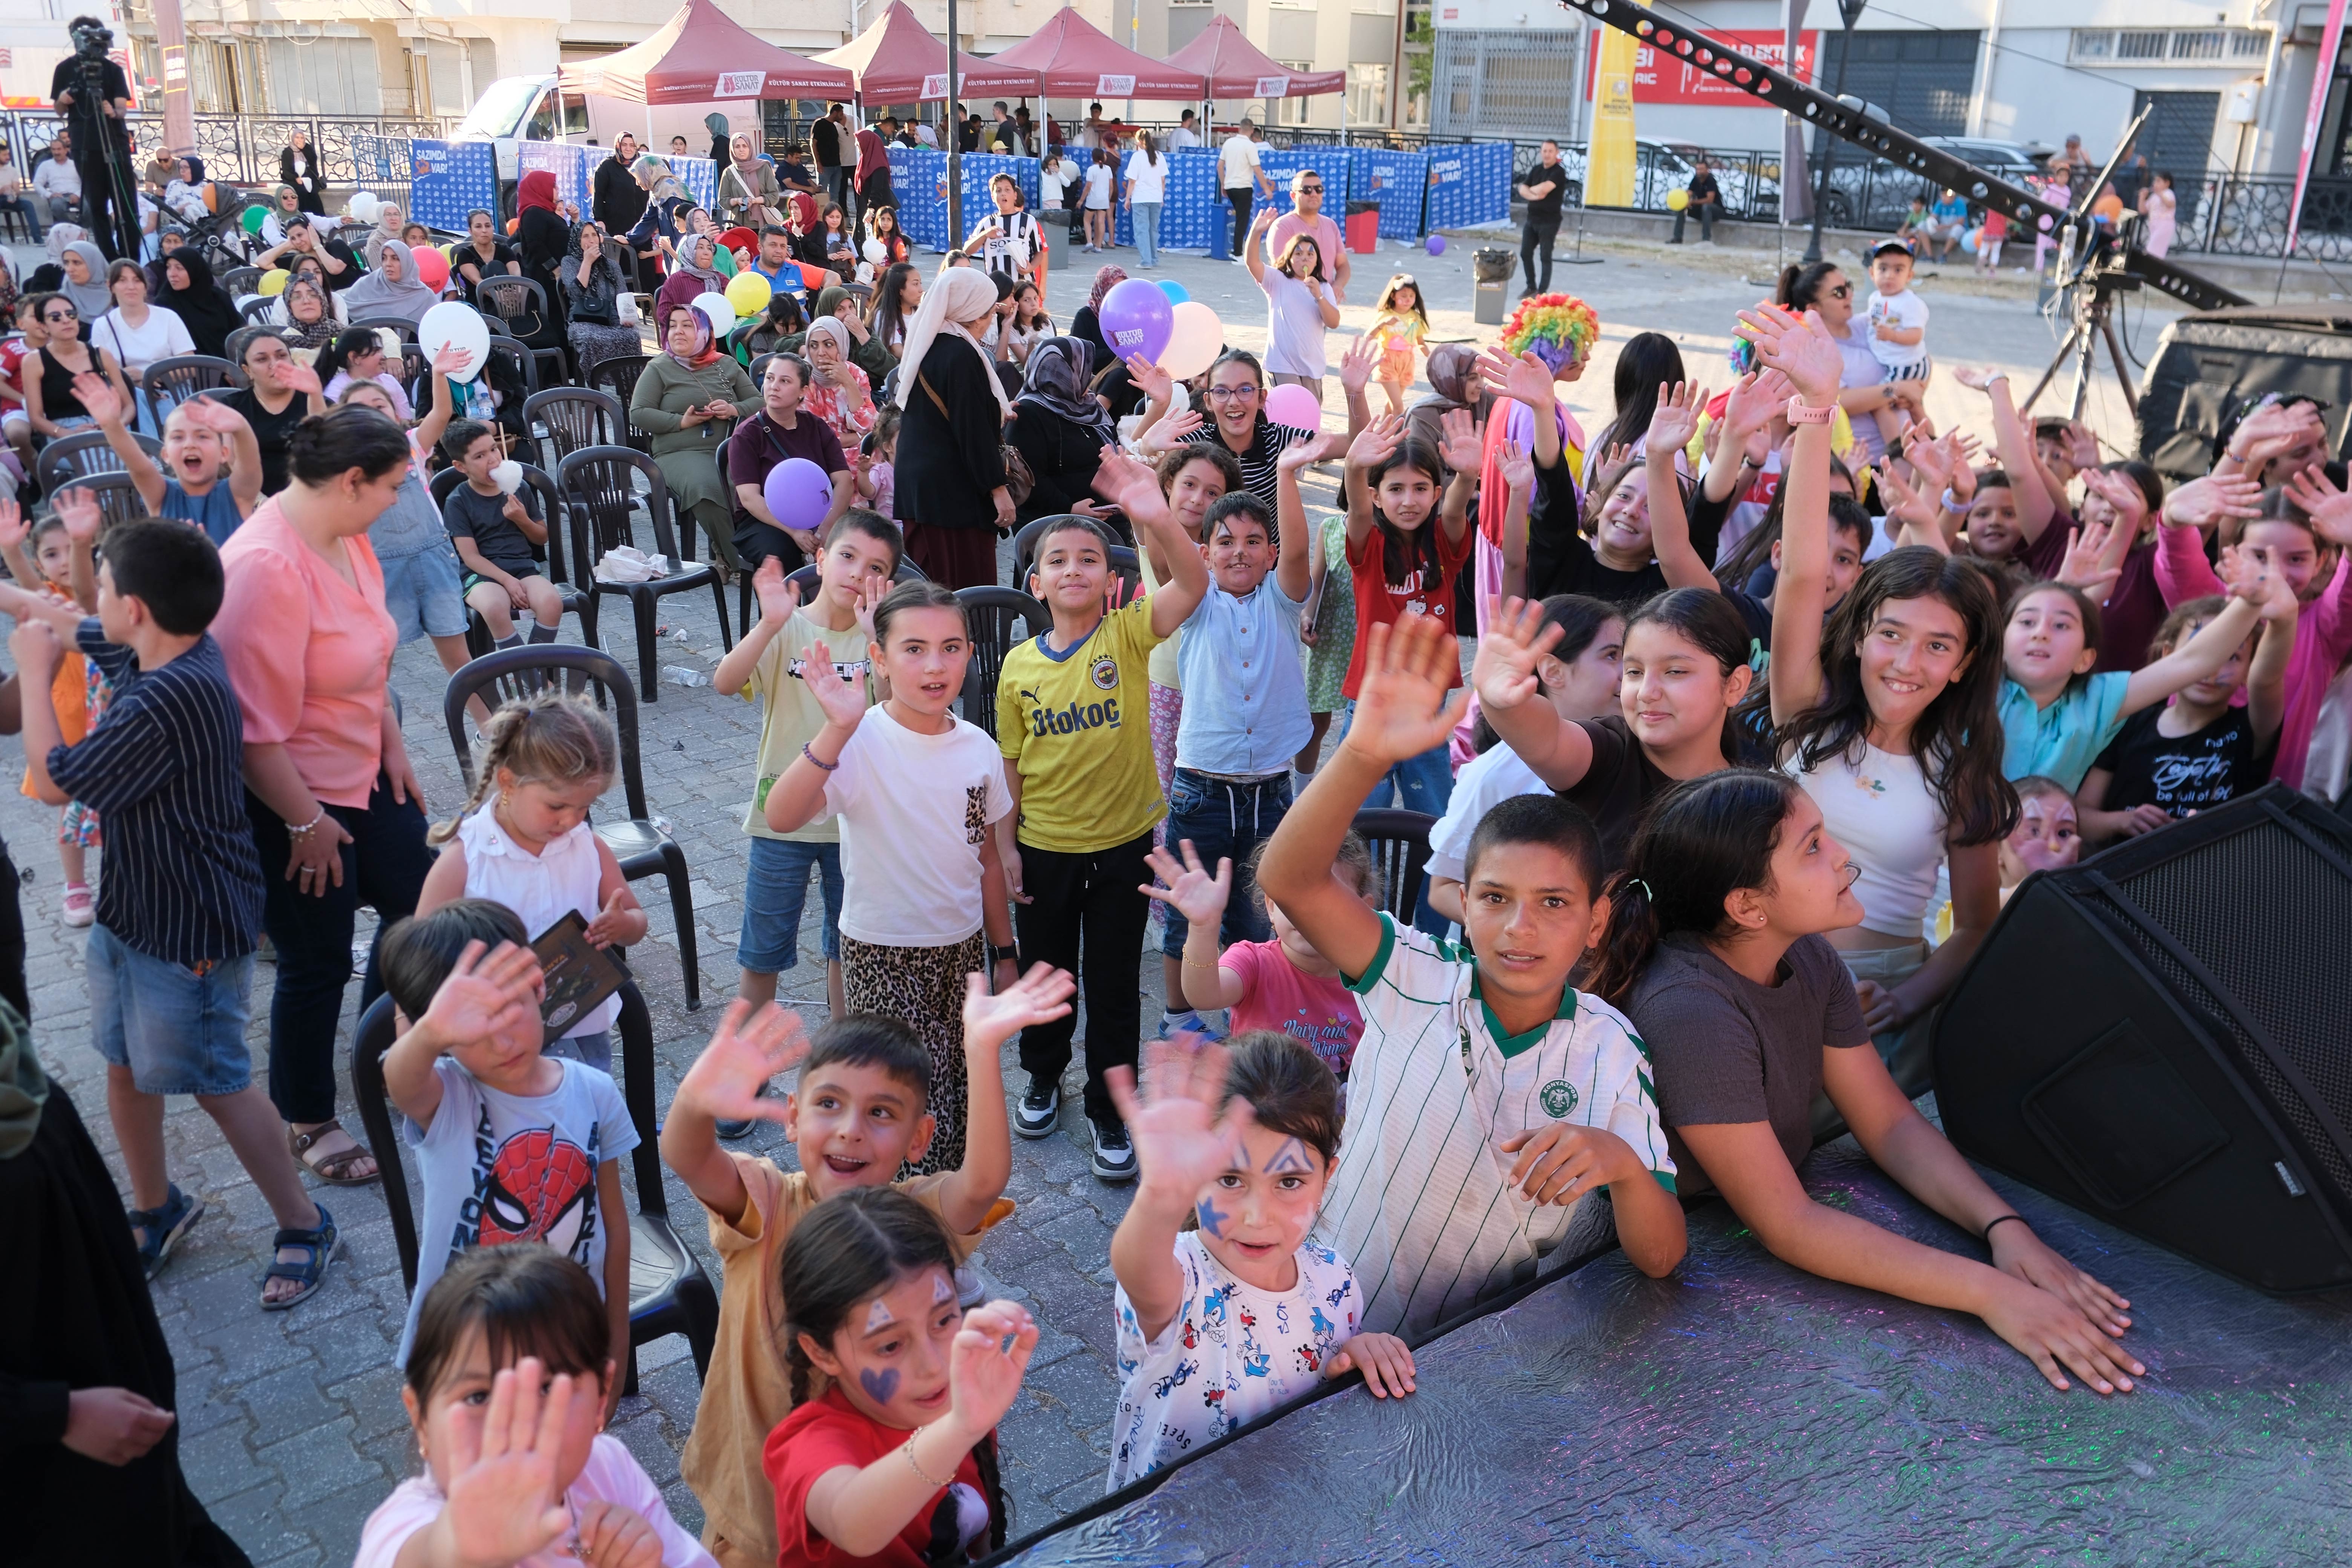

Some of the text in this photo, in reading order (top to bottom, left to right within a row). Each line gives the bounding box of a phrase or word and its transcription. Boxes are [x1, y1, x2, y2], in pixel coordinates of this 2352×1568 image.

[1738, 44, 1805, 61] ELEKTK
[735, 81, 759, 90] SANAT
[416, 150, 447, 161] SAZIMDA
[431, 163, 448, 174] VAR!
[522, 157, 548, 168] SAZIMDA
[1432, 159, 1461, 173] AZIMDA
[936, 168, 969, 183] SADA
[1372, 166, 1394, 177] SAZIMDA
[1442, 170, 1462, 184] VAR!
[893, 178, 909, 189] VAR!
[1118, 335, 1144, 346] SANAT
[1032, 698, 1121, 737] Otokoç
[2156, 789, 2173, 802] be
[1321, 1021, 1352, 1039] and
[1311, 1040, 1351, 1057] Minnie
[1543, 1081, 1577, 1099] KONYASPOR
